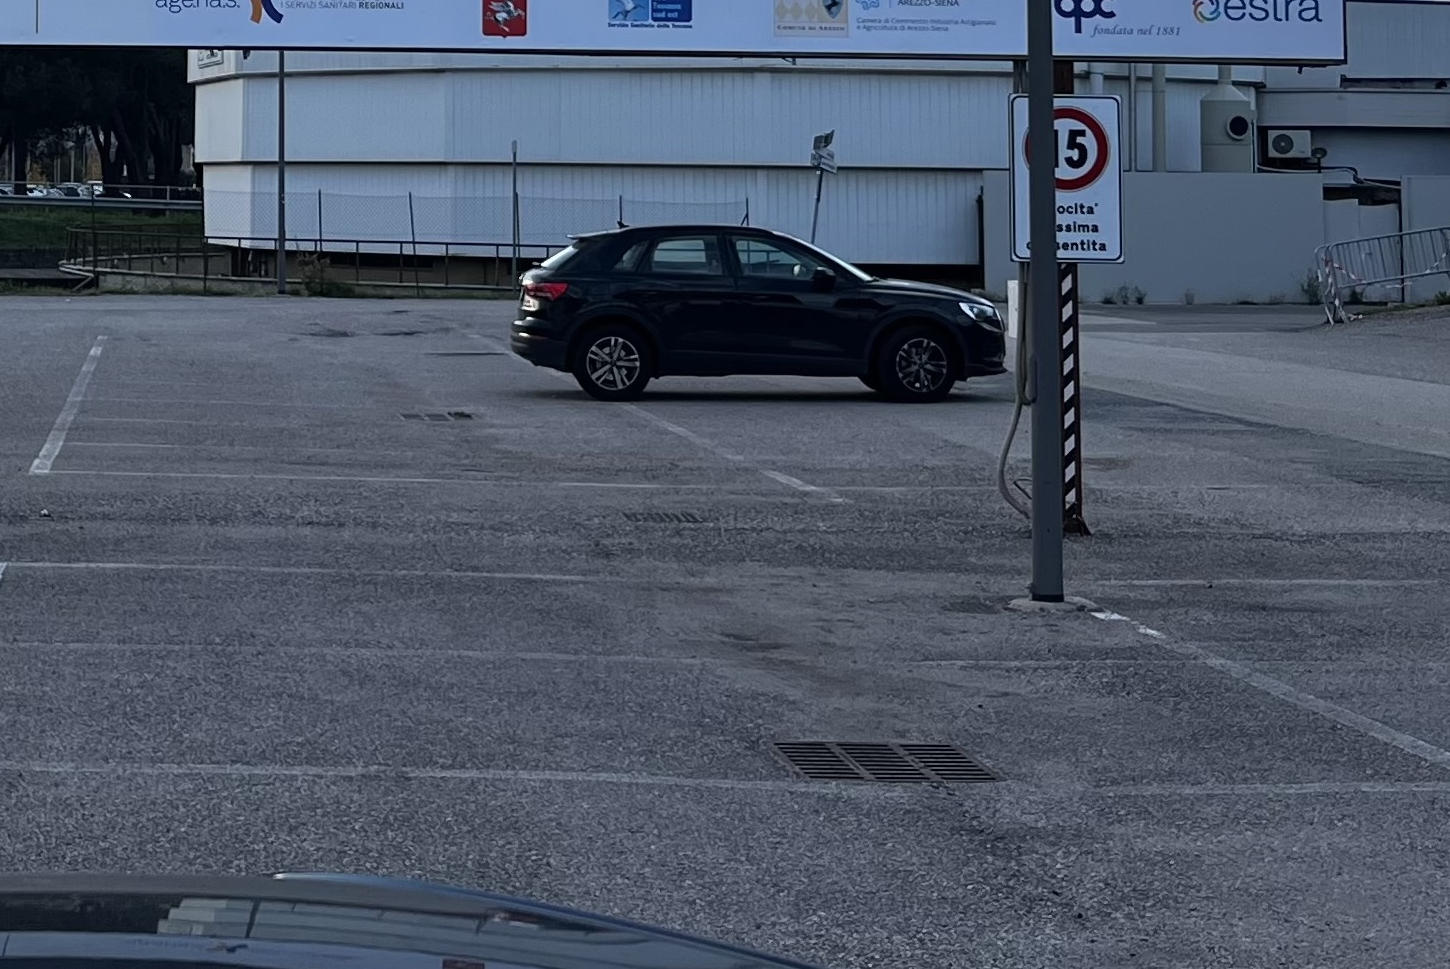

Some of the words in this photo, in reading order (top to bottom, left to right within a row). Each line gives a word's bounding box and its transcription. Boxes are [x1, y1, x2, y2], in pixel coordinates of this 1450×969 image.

[286, 1, 316, 9] SERVIZI
[319, 1, 357, 9] SANITARI
[1090, 24, 1134, 37] fondata
[1137, 25, 1153, 35] nel
[1156, 26, 1180, 36] 1881
